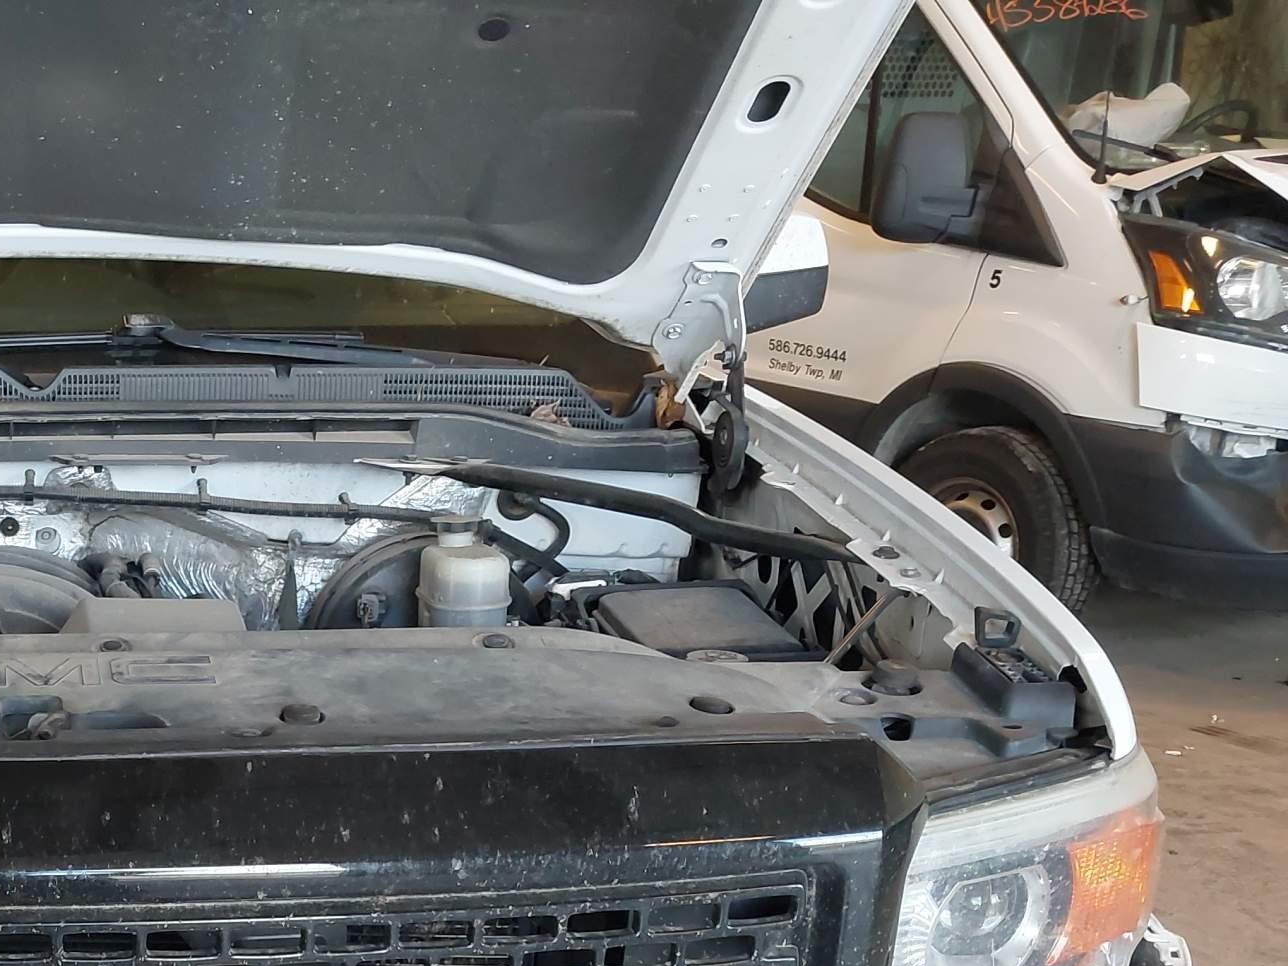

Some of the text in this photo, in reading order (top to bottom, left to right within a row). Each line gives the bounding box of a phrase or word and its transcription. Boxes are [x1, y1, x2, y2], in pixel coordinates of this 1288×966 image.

[989, 269, 1002, 289] 5
[768, 338, 847, 362] 586.726.9444
[768, 358, 843, 381] Shelby Twp, MI
